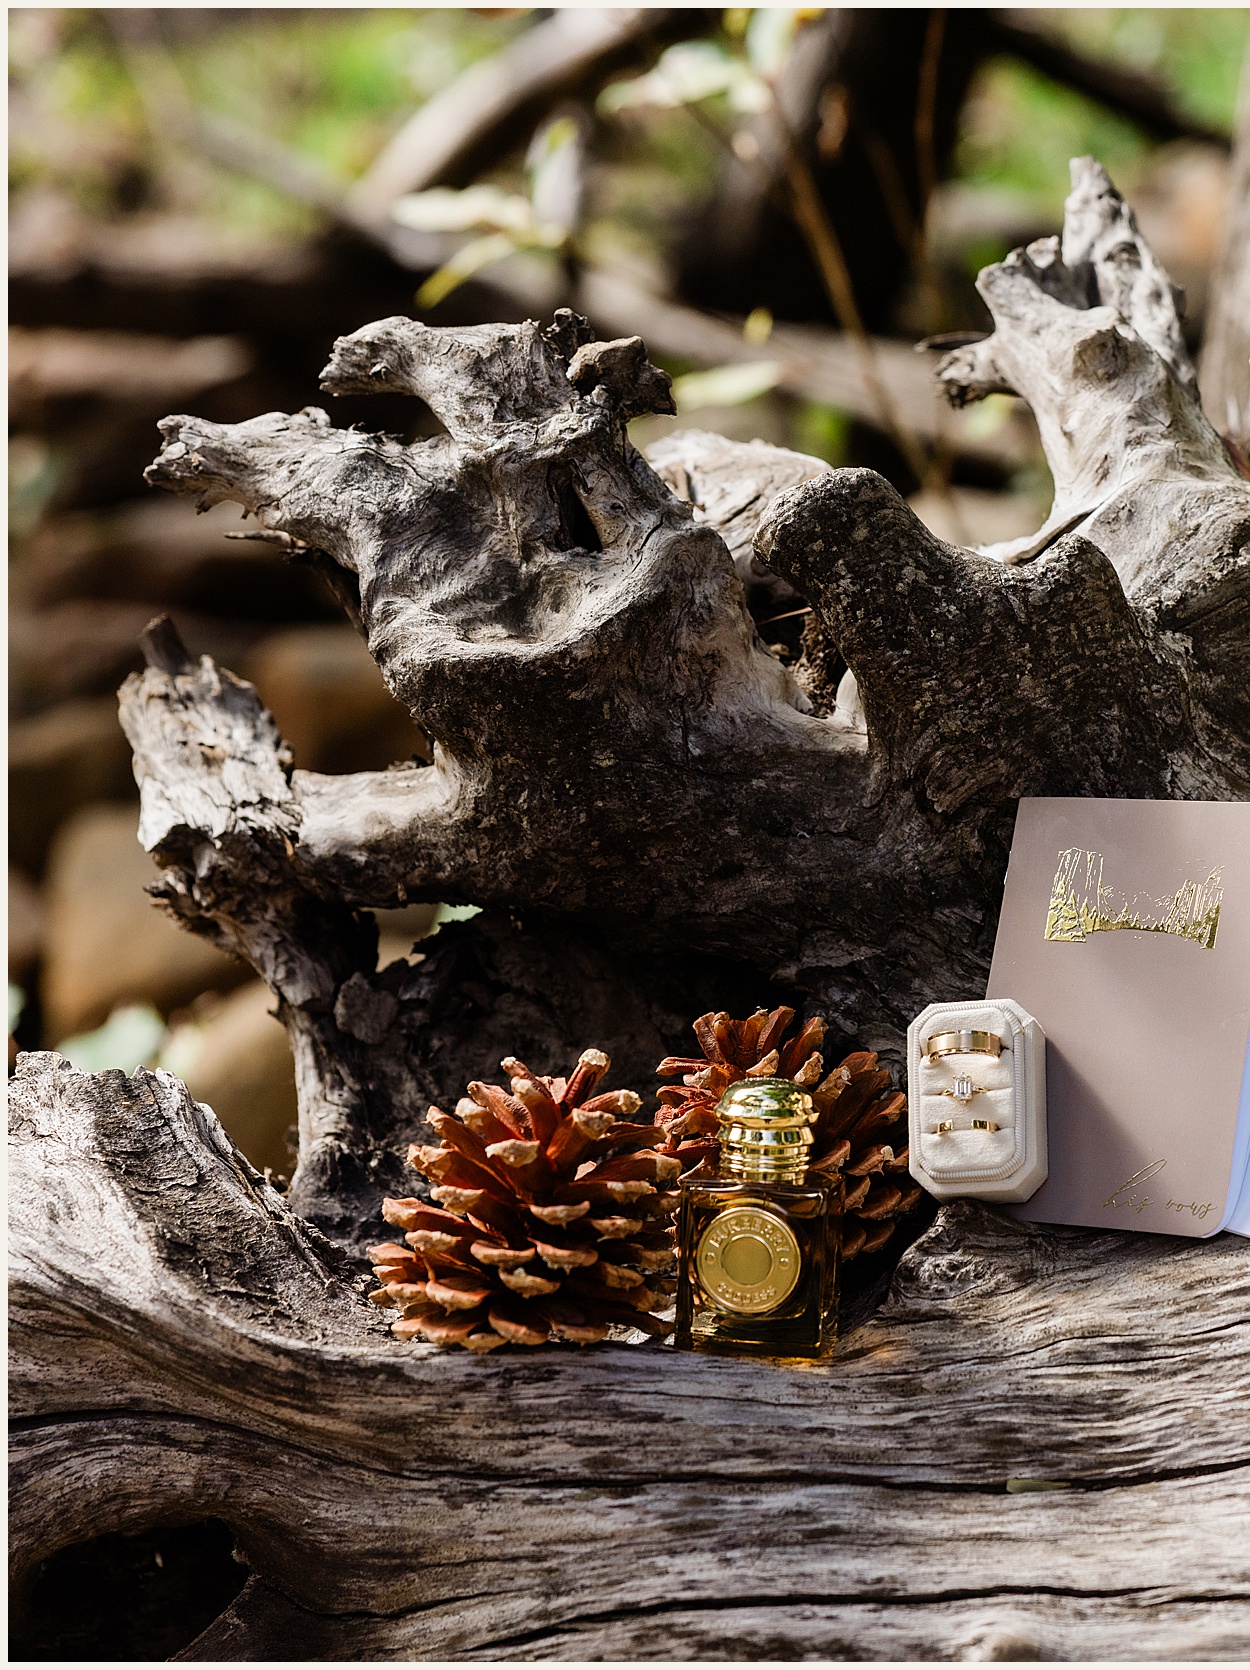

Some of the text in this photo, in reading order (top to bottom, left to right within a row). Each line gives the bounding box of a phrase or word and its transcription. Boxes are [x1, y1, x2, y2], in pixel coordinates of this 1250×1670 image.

[1103, 1158, 1218, 1219] his vows
[709, 1217, 790, 1252] BURBERRY
